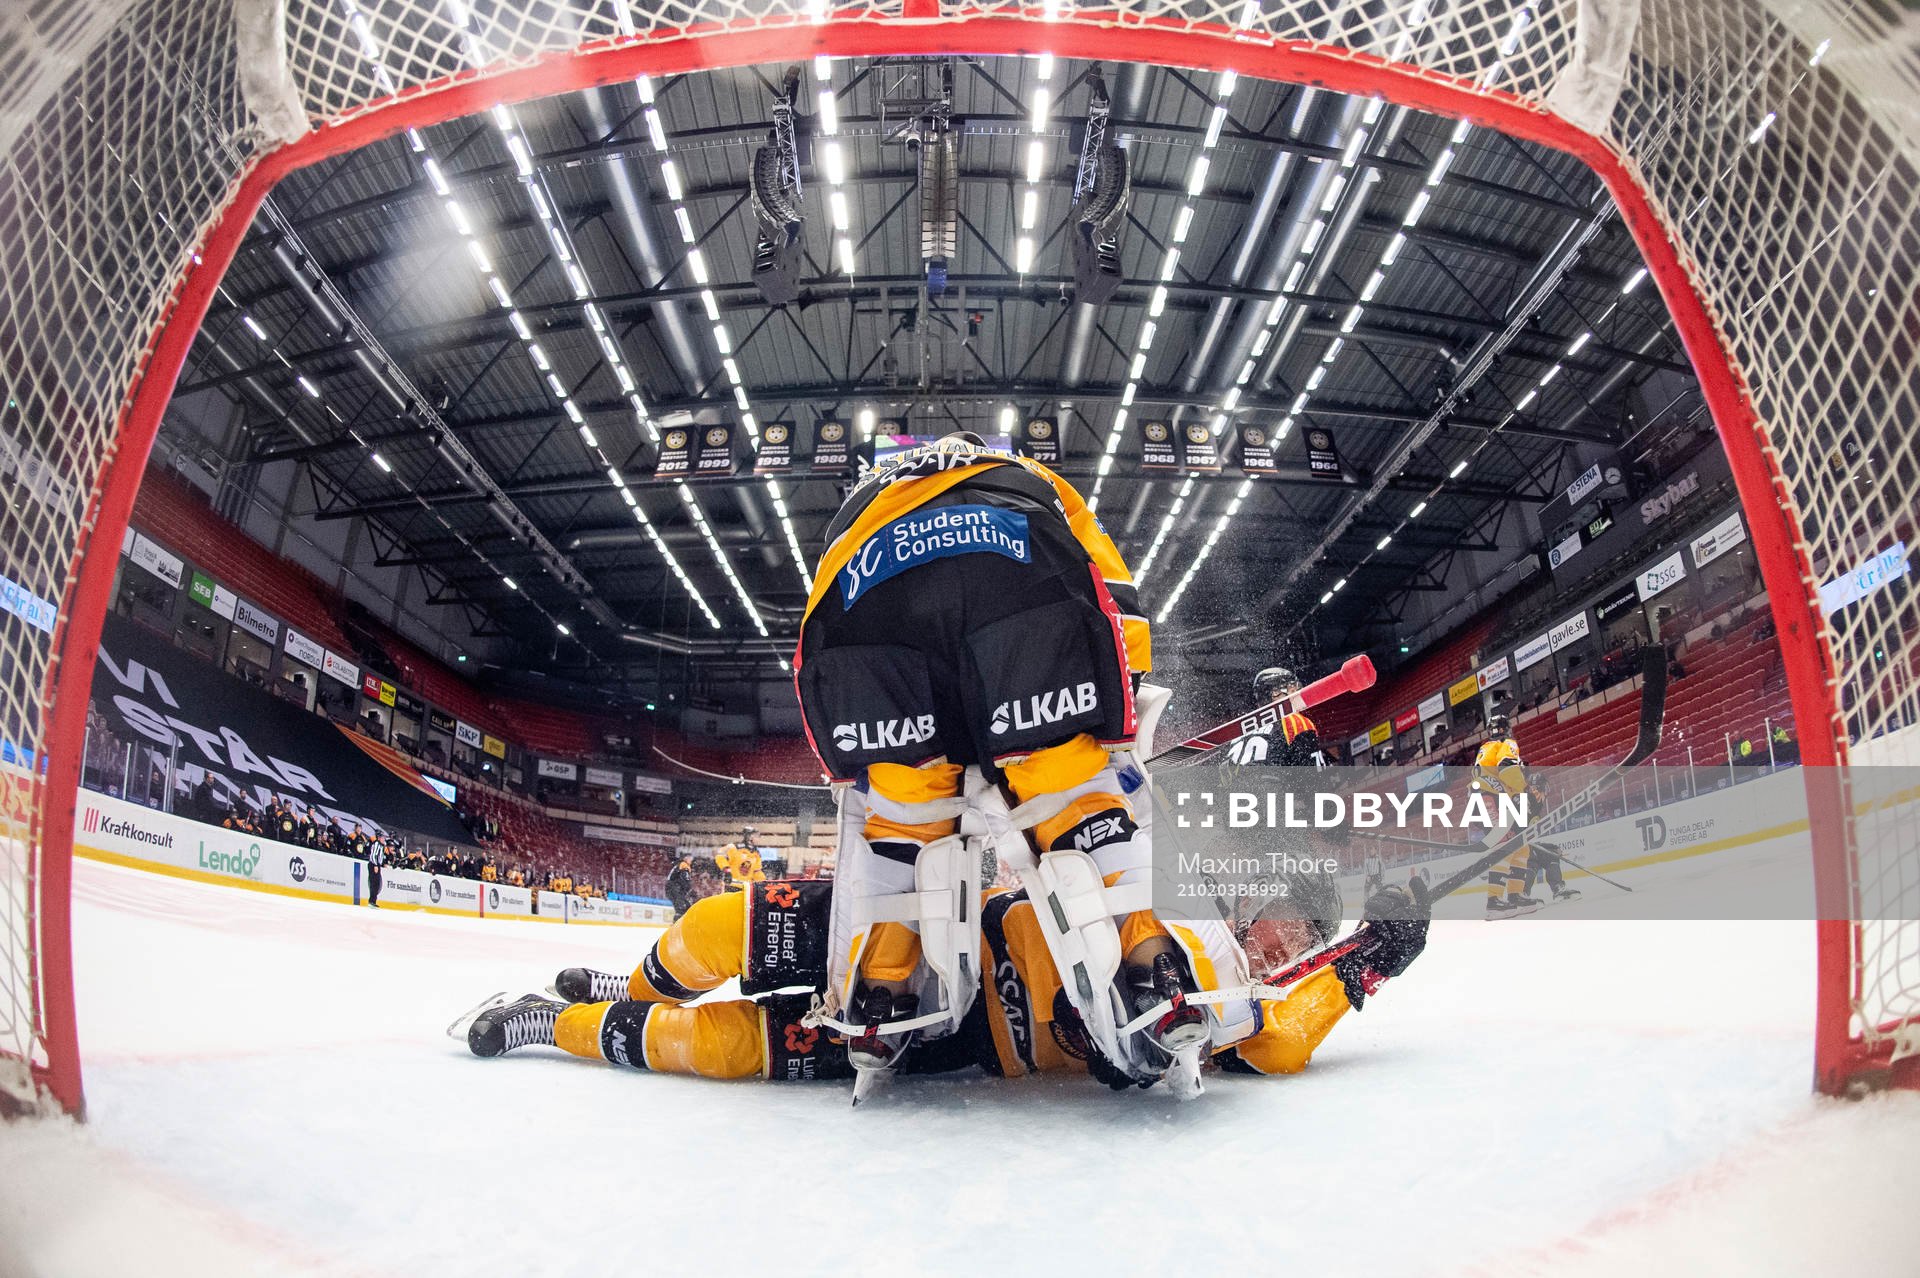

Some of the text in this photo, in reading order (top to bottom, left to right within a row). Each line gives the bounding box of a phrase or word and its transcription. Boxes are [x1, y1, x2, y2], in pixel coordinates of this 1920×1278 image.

[656, 461, 689, 471] 2012
[698, 458, 730, 468] 1999
[757, 456, 791, 466] 1993
[814, 454, 848, 464] 1980
[1033, 452, 1057, 461] 971
[1143, 454, 1176, 463] 1968
[1186, 455, 1217, 465] 1967
[1243, 458, 1274, 467] 1966
[1310, 461, 1338, 470] 1964
[1575, 467, 1598, 490] STENA
[893, 510, 990, 543] Student
[895, 525, 1025, 562] Consulting
[1660, 565, 1676, 585] SSG
[193, 581, 211, 598] SEB
[237, 606, 275, 638] Bilmetro
[1551, 619, 1585, 648] gavle.se
[1012, 681, 1098, 731] LKAB
[457, 725, 479, 742] SKF
[860, 713, 936, 750] LKAB
[112, 694, 338, 802] STÅR
[101, 815, 173, 849] Kraftkonsult
[1073, 815, 1126, 851] NEX
[1635, 815, 1666, 851] TD
[1669, 818, 1715, 837] TUNGA DELAR
[1670, 830, 1708, 845] SVERIGE AB
[199, 841, 253, 876] Lendo
[764, 911, 781, 968] Energi
[782, 912, 797, 962] Luleå
